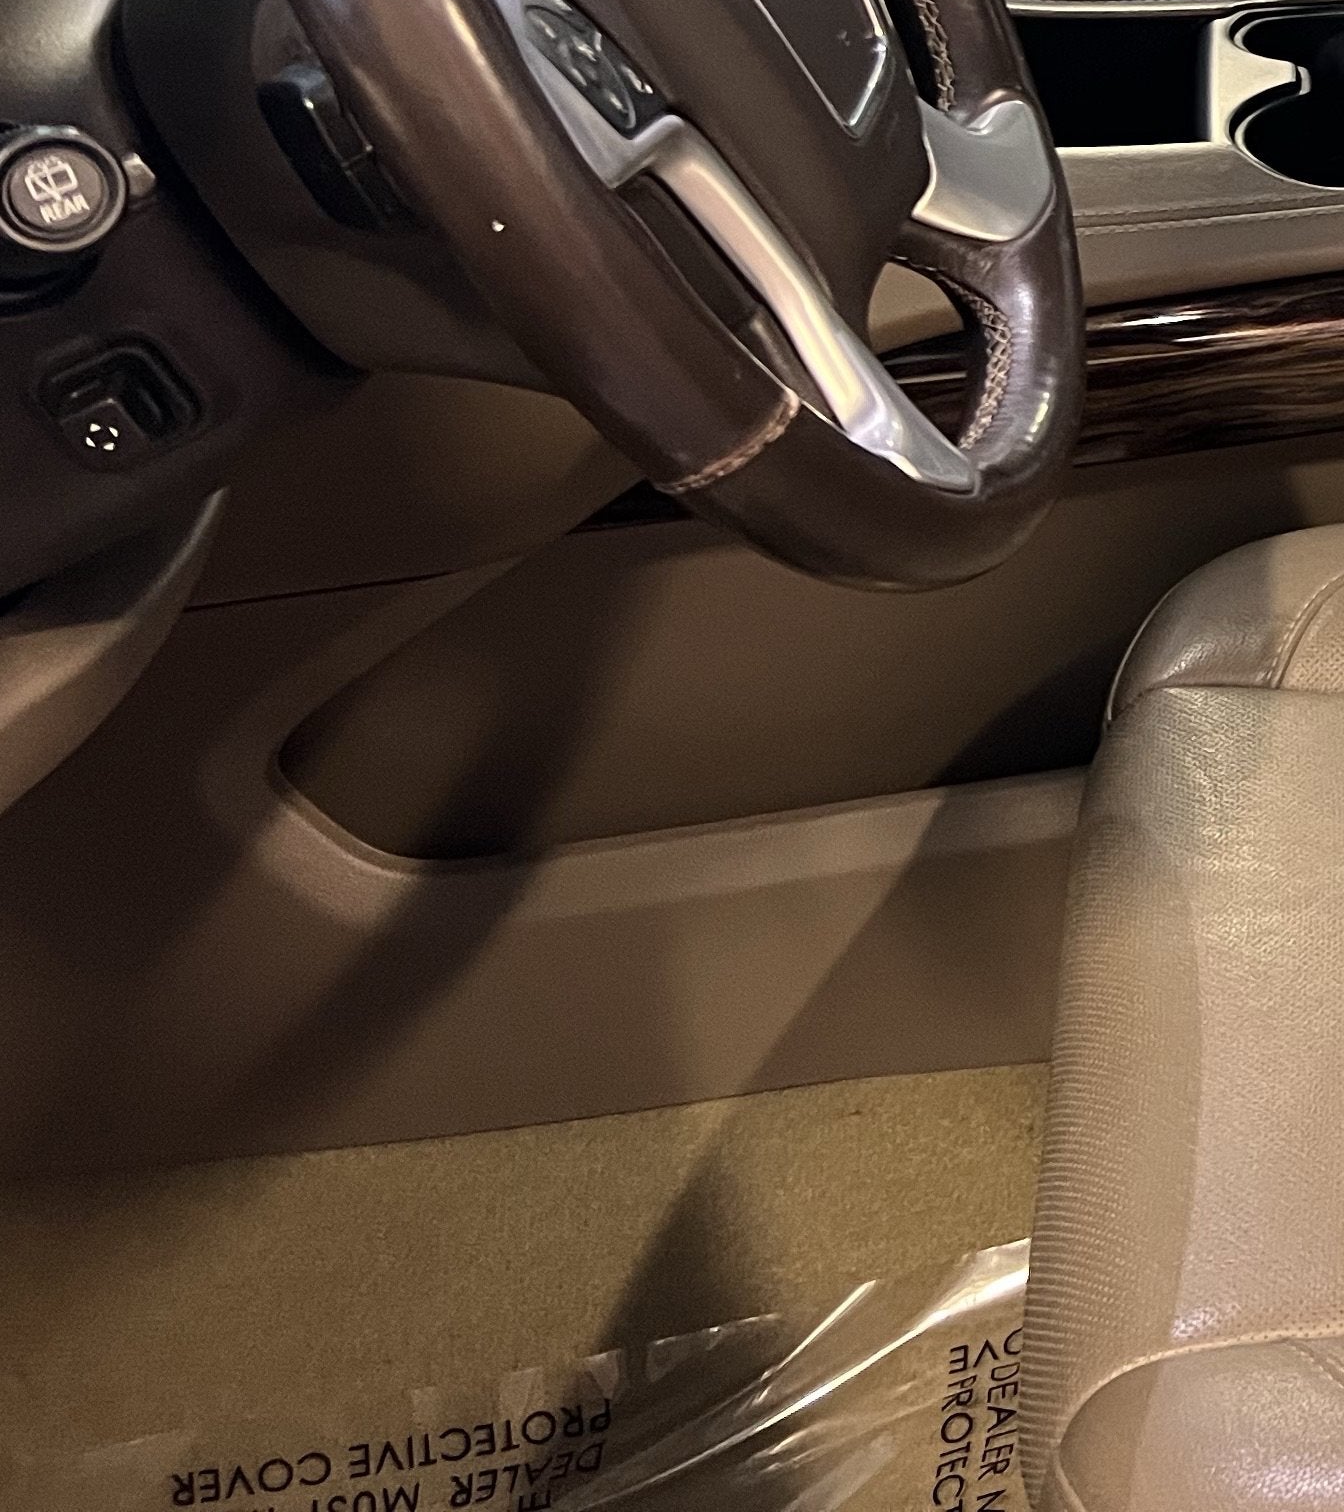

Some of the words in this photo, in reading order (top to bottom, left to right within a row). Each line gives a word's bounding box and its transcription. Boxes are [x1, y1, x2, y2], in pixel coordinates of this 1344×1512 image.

[39, 194, 90, 224] REAR
[348, 1398, 612, 1480] PROTECTIVE
[977, 1361, 1021, 1481] DEALER
[171, 1451, 332, 1506] COVER
[450, 1441, 604, 1507] DEALER
